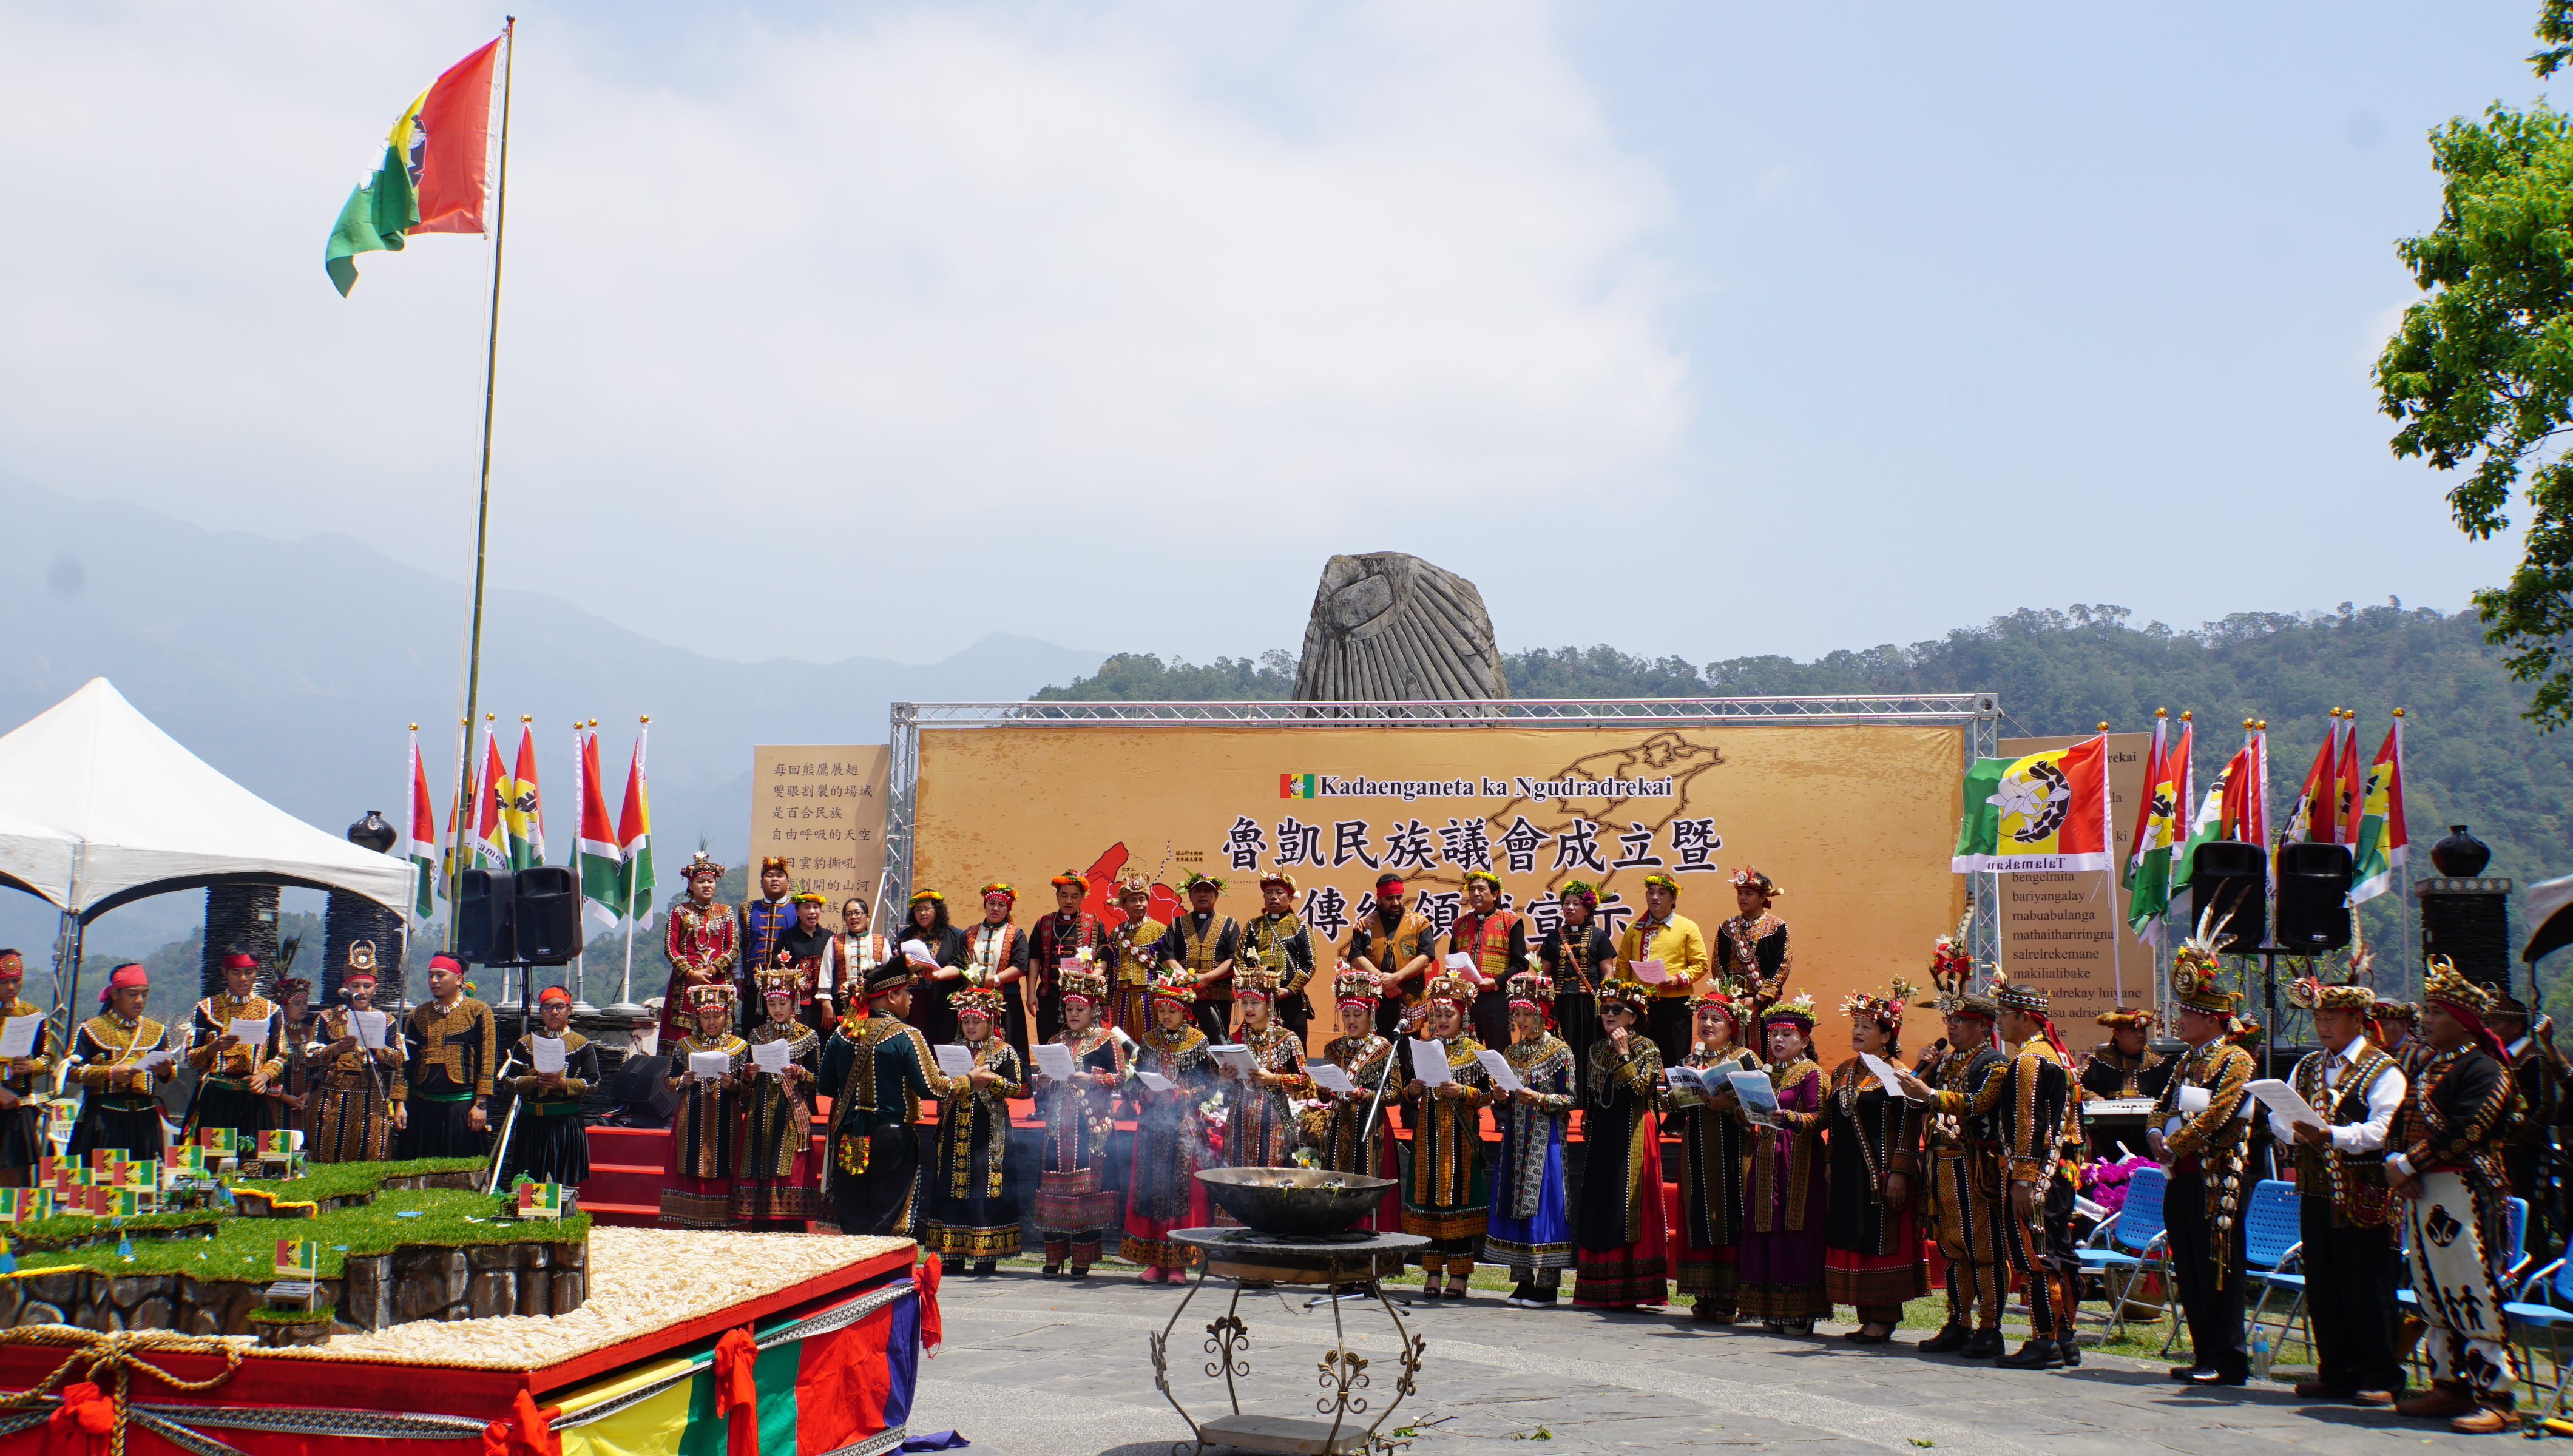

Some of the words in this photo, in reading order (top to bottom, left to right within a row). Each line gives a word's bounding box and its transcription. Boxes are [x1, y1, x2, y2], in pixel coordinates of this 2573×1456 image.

[773, 763, 859, 777] 每回熊鷹展翅
[773, 784, 873, 798] 雙眼割裂的場域
[1322, 777, 1474, 800] Kadaenganeta
[1483, 777, 1507, 795] ka
[1515, 777, 1672, 800] Ngudradrekai
[771, 806, 843, 819] 是百合民族
[773, 827, 871, 841] 自由呼吸的天空
[1223, 817, 1722, 872] 魯凱民族議會成立暨
[774, 856, 856, 870] 日雲豹撕吼
[2012, 891, 2085, 903] bariyangalay
[1299, 887, 1633, 942] 傳領宣示
[2012, 910, 2095, 922] mabuabulanga
[2012, 929, 2114, 942] mathaithariringna
[2013, 948, 2100, 959] salrelrekemane
[2013, 968, 2091, 979] makilialibake
